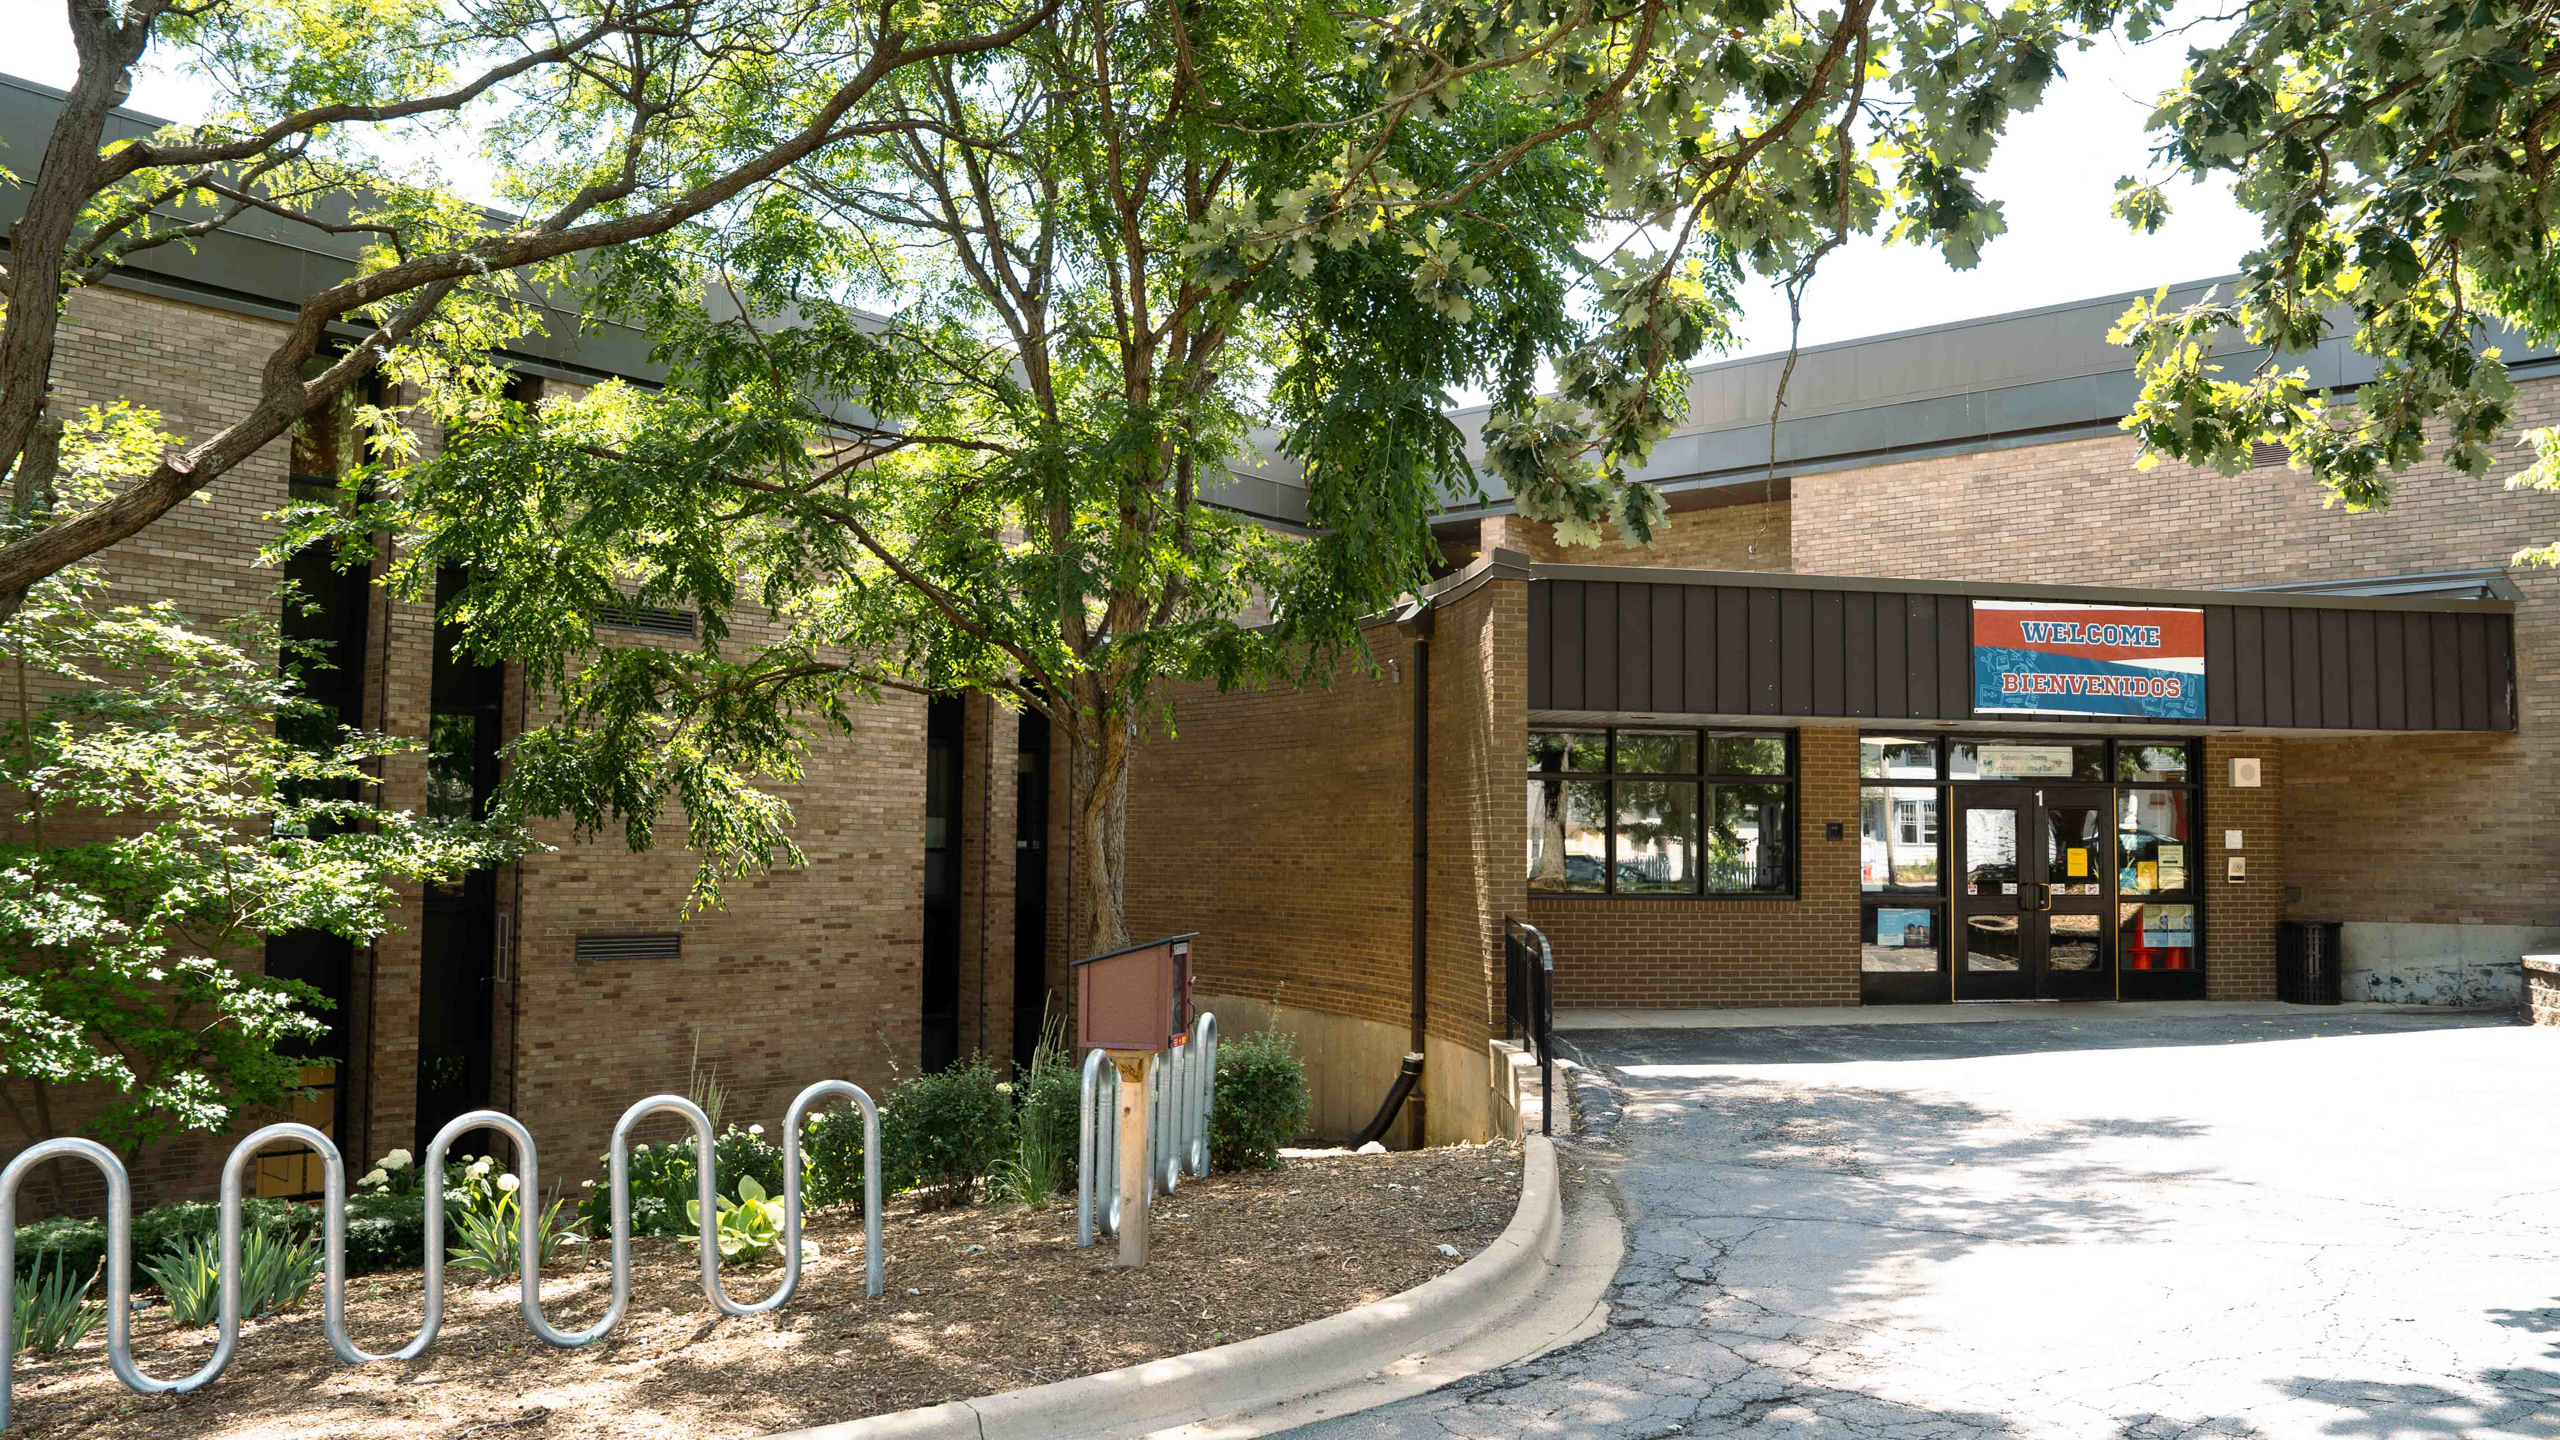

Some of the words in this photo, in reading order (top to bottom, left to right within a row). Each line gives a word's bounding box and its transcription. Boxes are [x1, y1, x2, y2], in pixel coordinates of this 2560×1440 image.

[2020, 621, 2161, 647] WELCOME
[2002, 673, 2181, 698] BIENVENIDOS
[2035, 790, 2044, 806] 1
